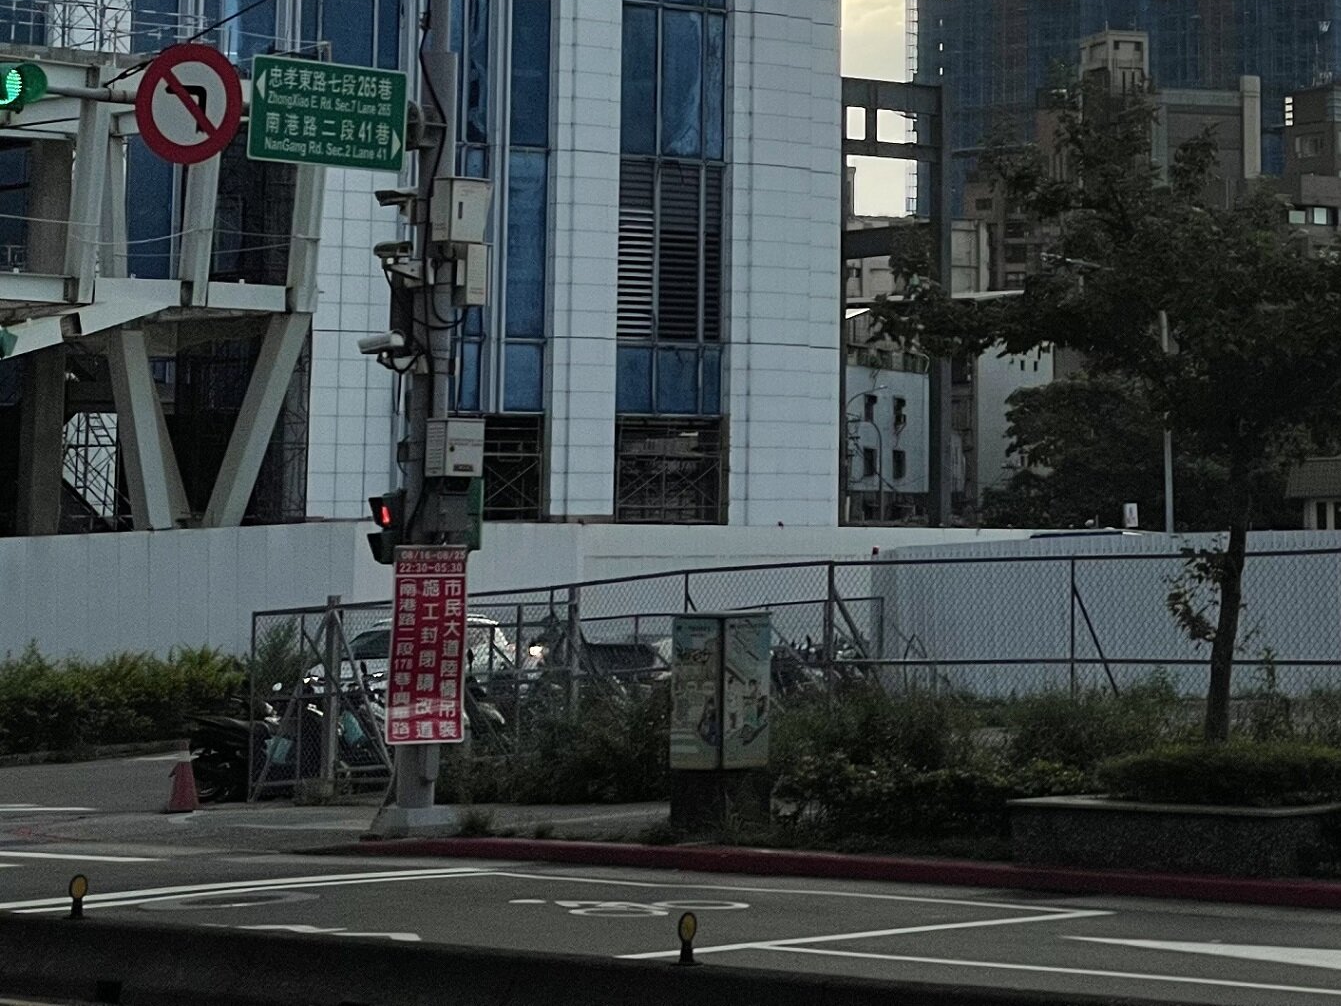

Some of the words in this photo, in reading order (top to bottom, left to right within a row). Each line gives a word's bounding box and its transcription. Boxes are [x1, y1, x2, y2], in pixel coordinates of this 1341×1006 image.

[268, 65, 392, 101] 忠孝東路七段265巷
[267, 90, 309, 109] ZhongXiao
[357, 100, 376, 114] Lane
[378, 103, 392, 116] 265
[265, 112, 390, 145] 南港路二段41巷
[264, 137, 307, 157] NanGang
[308, 141, 324, 155] Rd.
[352, 145, 375, 160] Lane
[376, 147, 387, 161] 41
